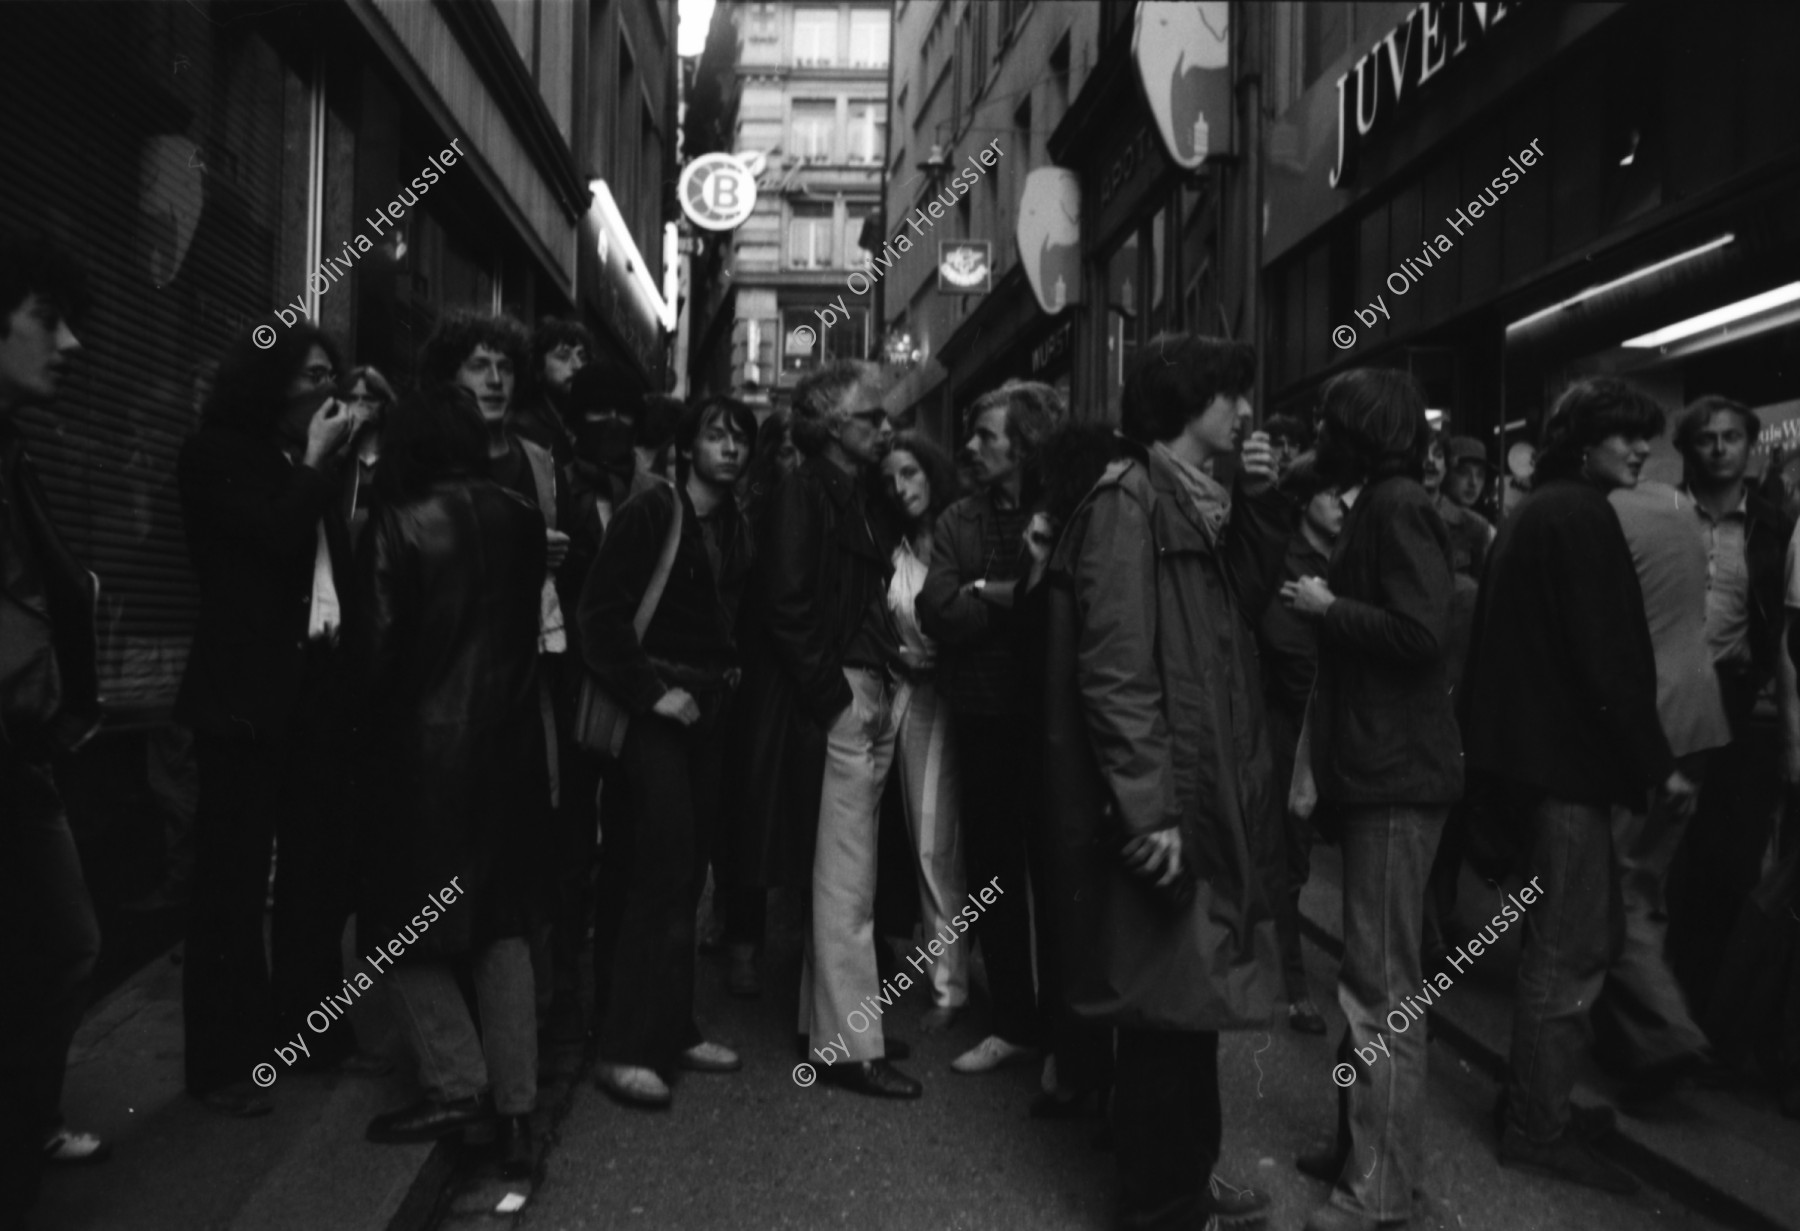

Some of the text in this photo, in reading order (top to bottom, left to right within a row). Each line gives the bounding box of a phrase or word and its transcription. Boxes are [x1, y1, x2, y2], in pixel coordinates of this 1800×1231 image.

[1329, 1, 1522, 189] JUVEN
[713, 174, 740, 209] B
[1100, 126, 1153, 209] APOT
